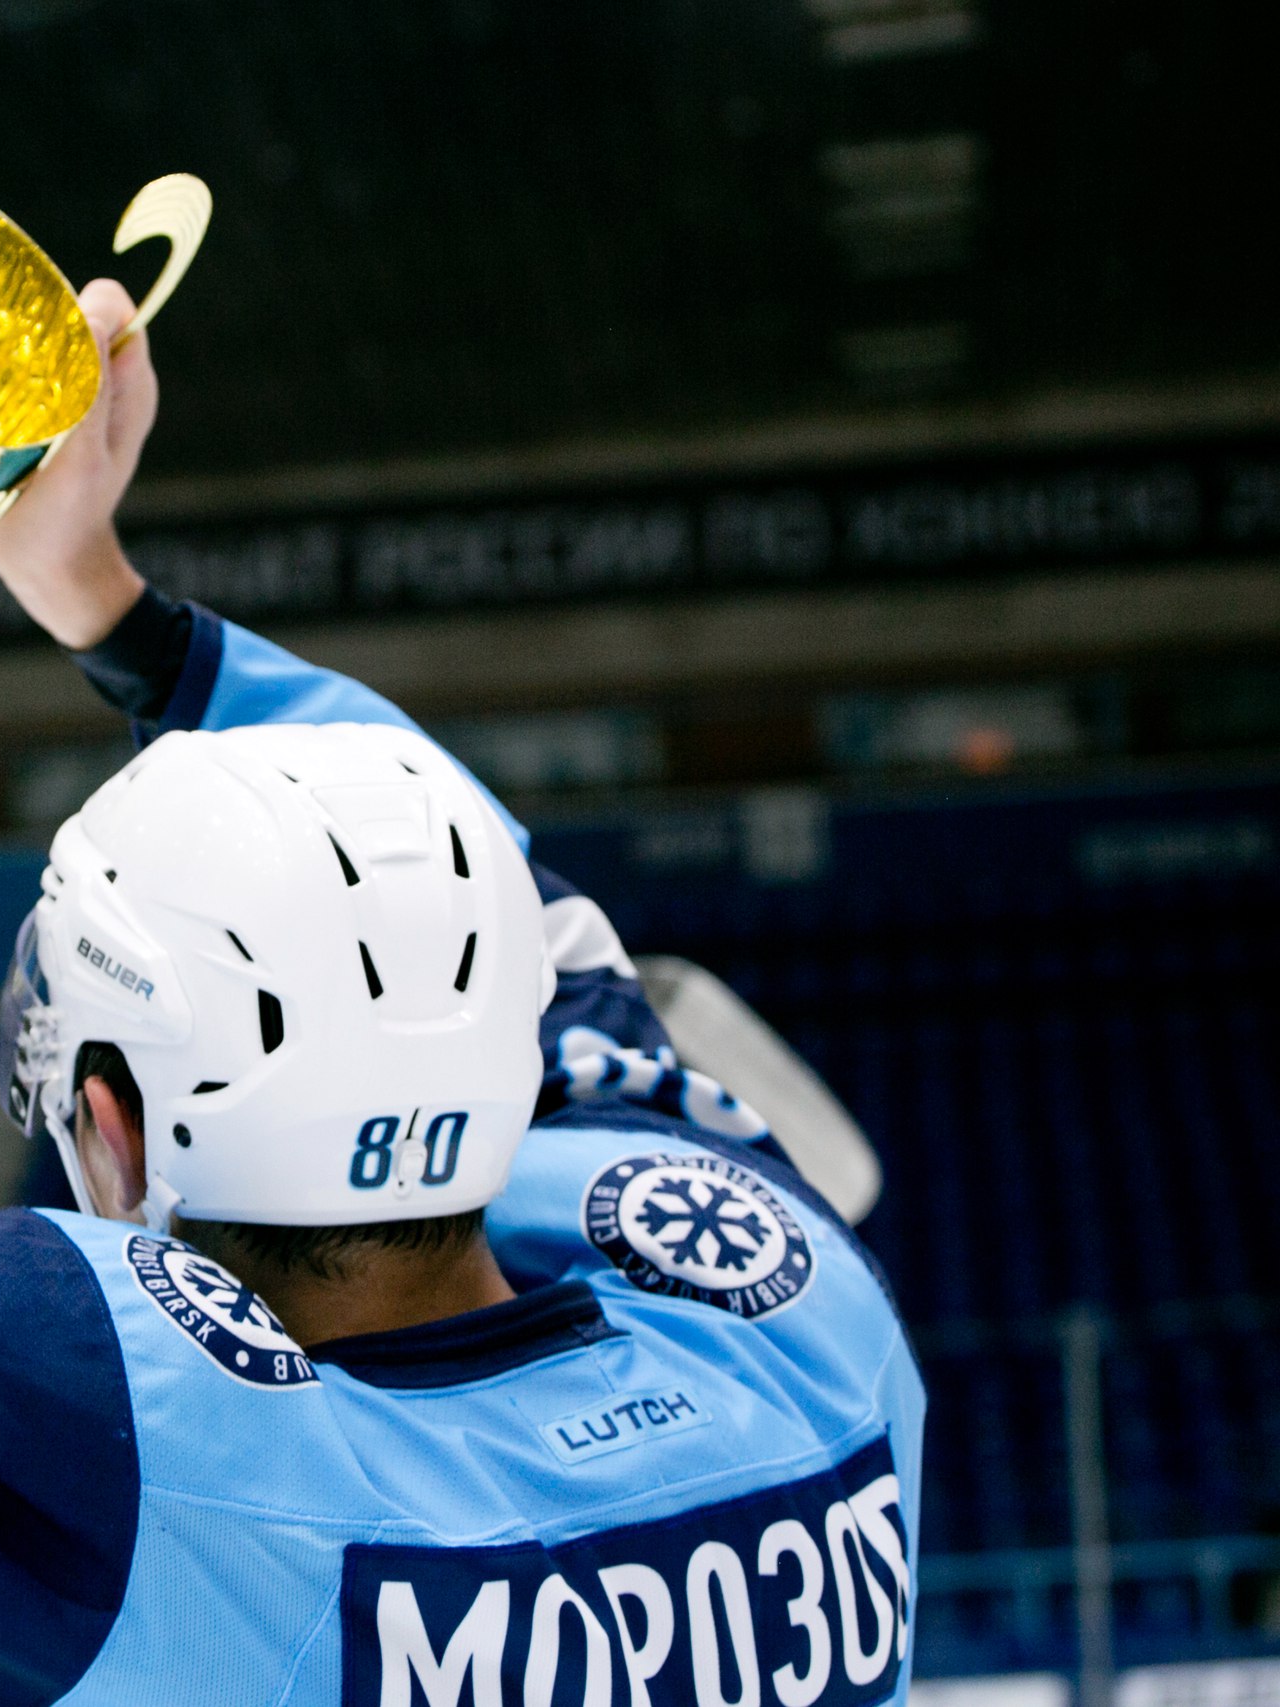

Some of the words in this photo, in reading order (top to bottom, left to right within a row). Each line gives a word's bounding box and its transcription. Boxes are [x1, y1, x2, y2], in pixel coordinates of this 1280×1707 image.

[349, 1111, 469, 1189] 80
[591, 1185, 620, 1244] CLUB
[556, 1392, 697, 1451] LUTCH
